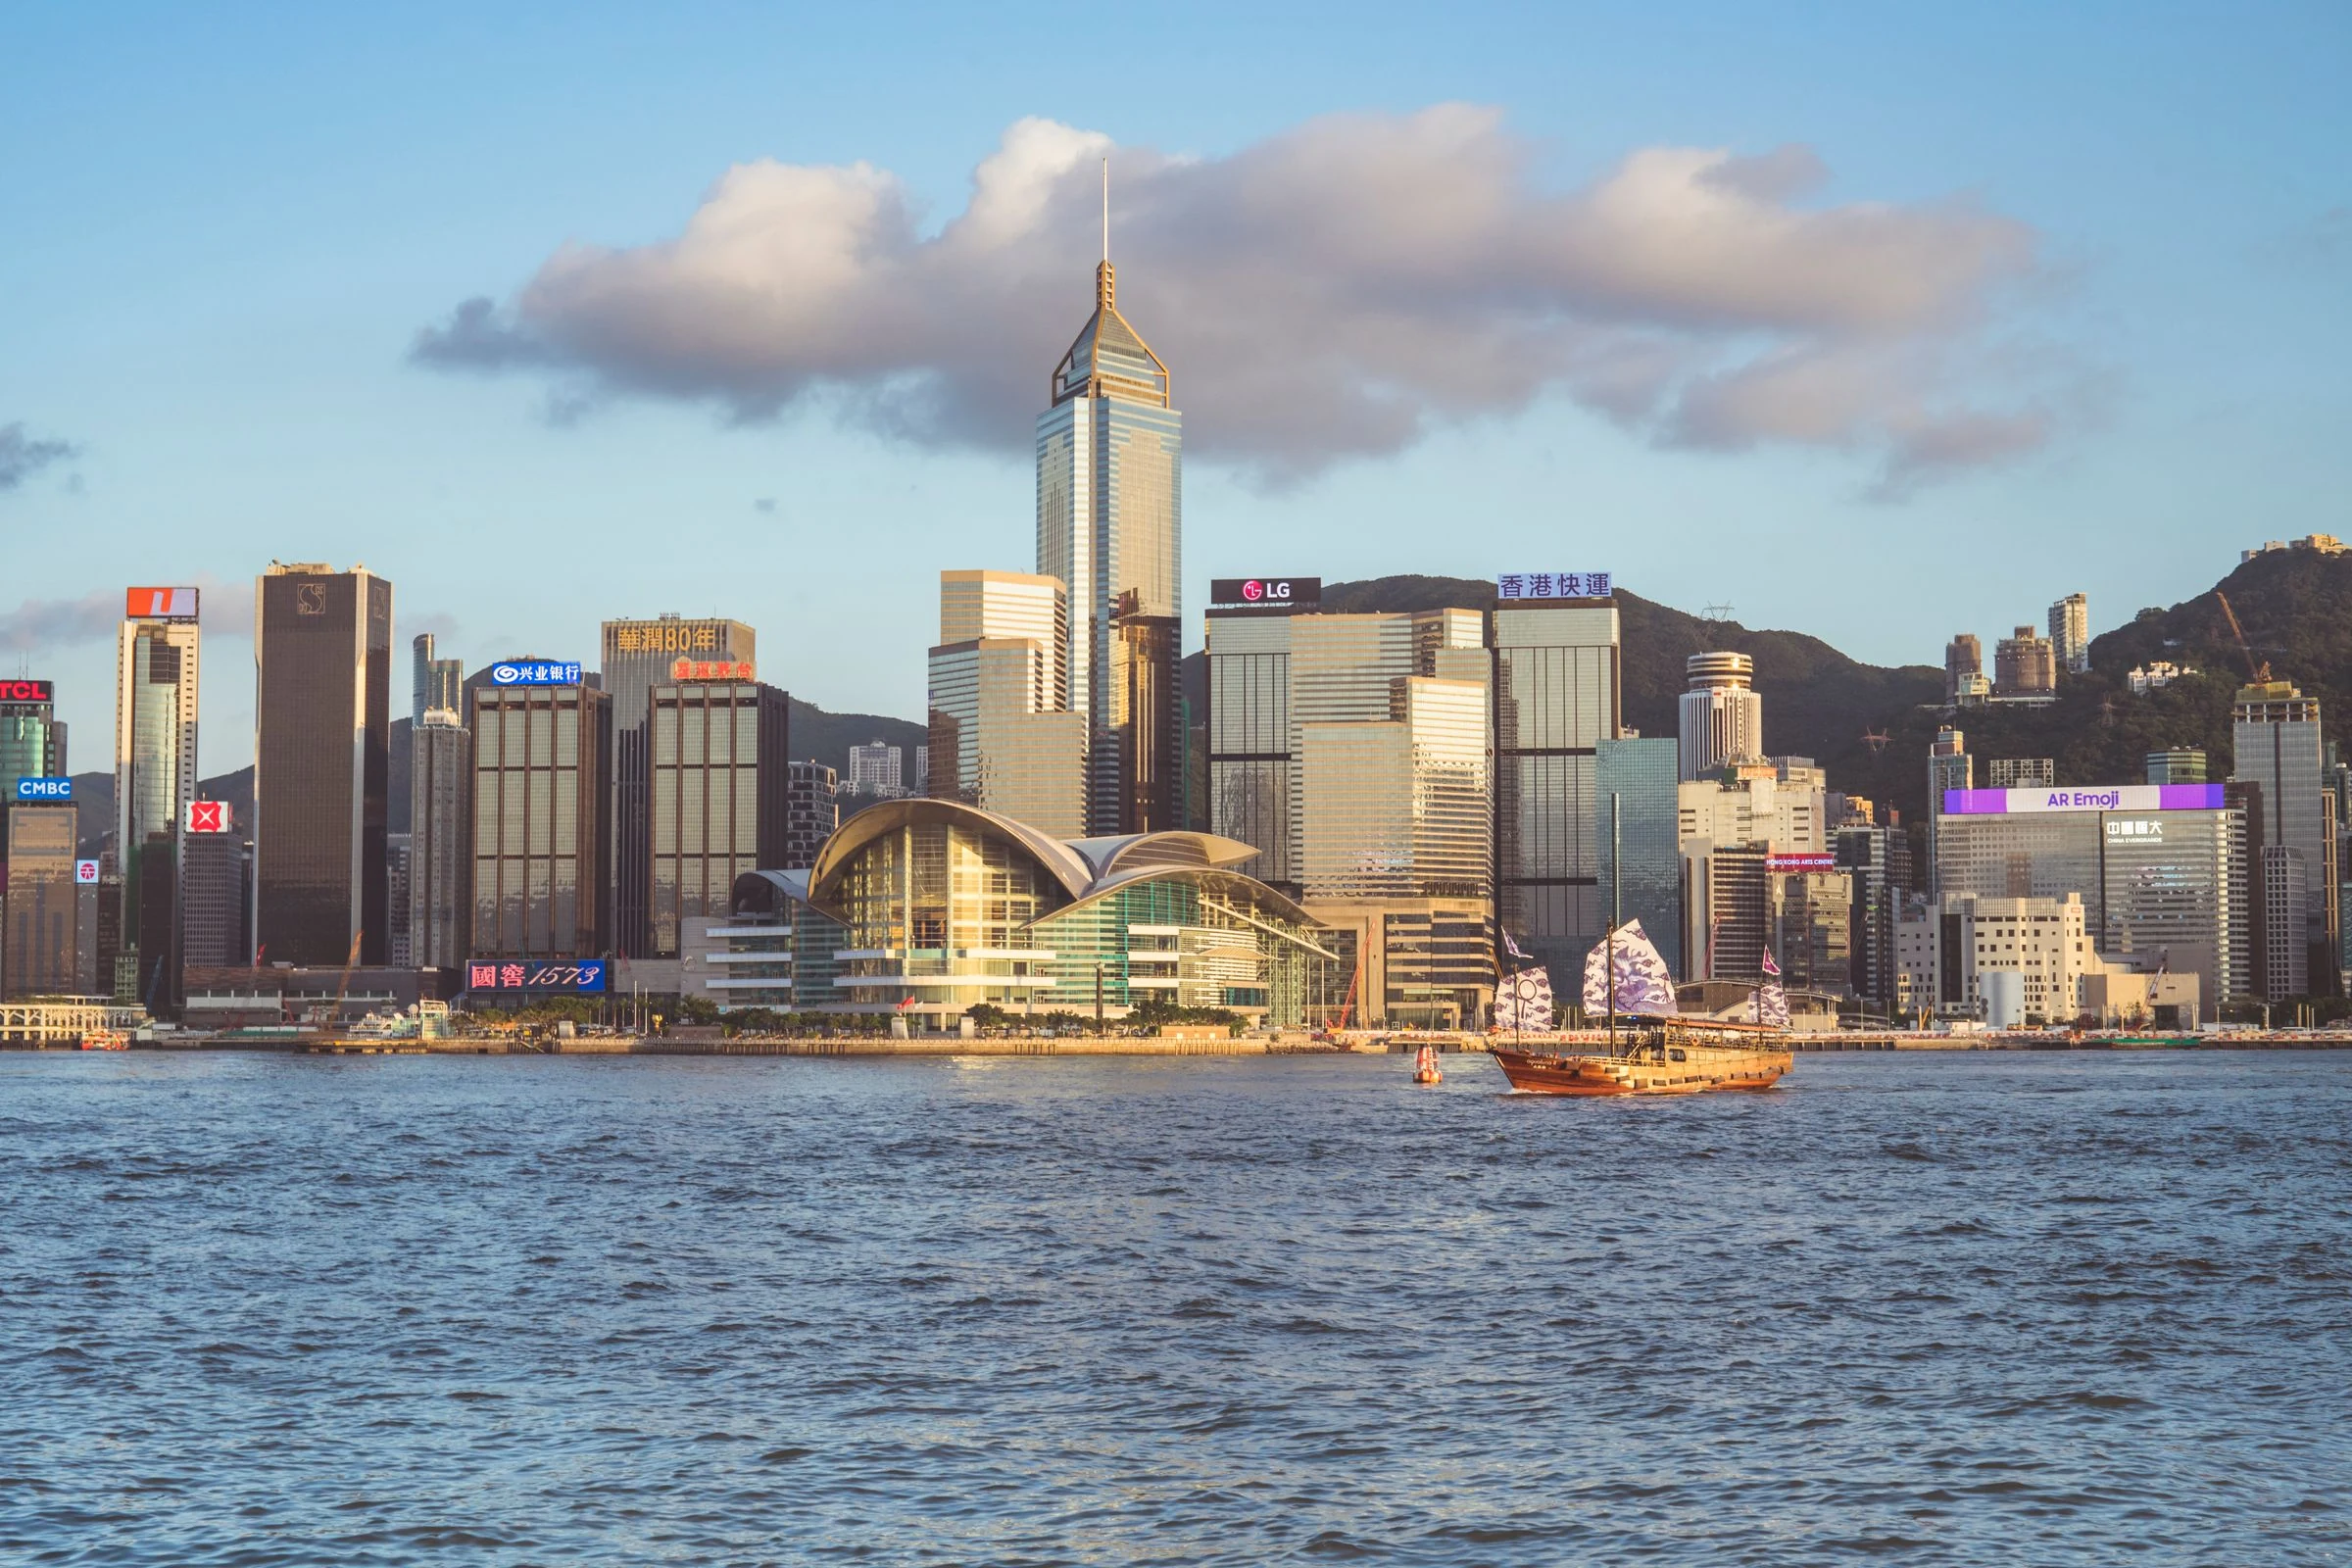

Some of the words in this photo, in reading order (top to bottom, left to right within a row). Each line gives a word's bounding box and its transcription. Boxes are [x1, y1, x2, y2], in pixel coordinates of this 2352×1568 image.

[1266, 582, 1291, 598] LG
[1500, 573, 1609, 597] 香港快運
[618, 627, 715, 652] 華潤80年
[519, 665, 579, 681] 兴业银行
[0, 682, 47, 700] TCL
[20, 782, 71, 795] CMBC
[2047, 793, 2070, 807] AR
[2074, 791, 2119, 809] Emoji
